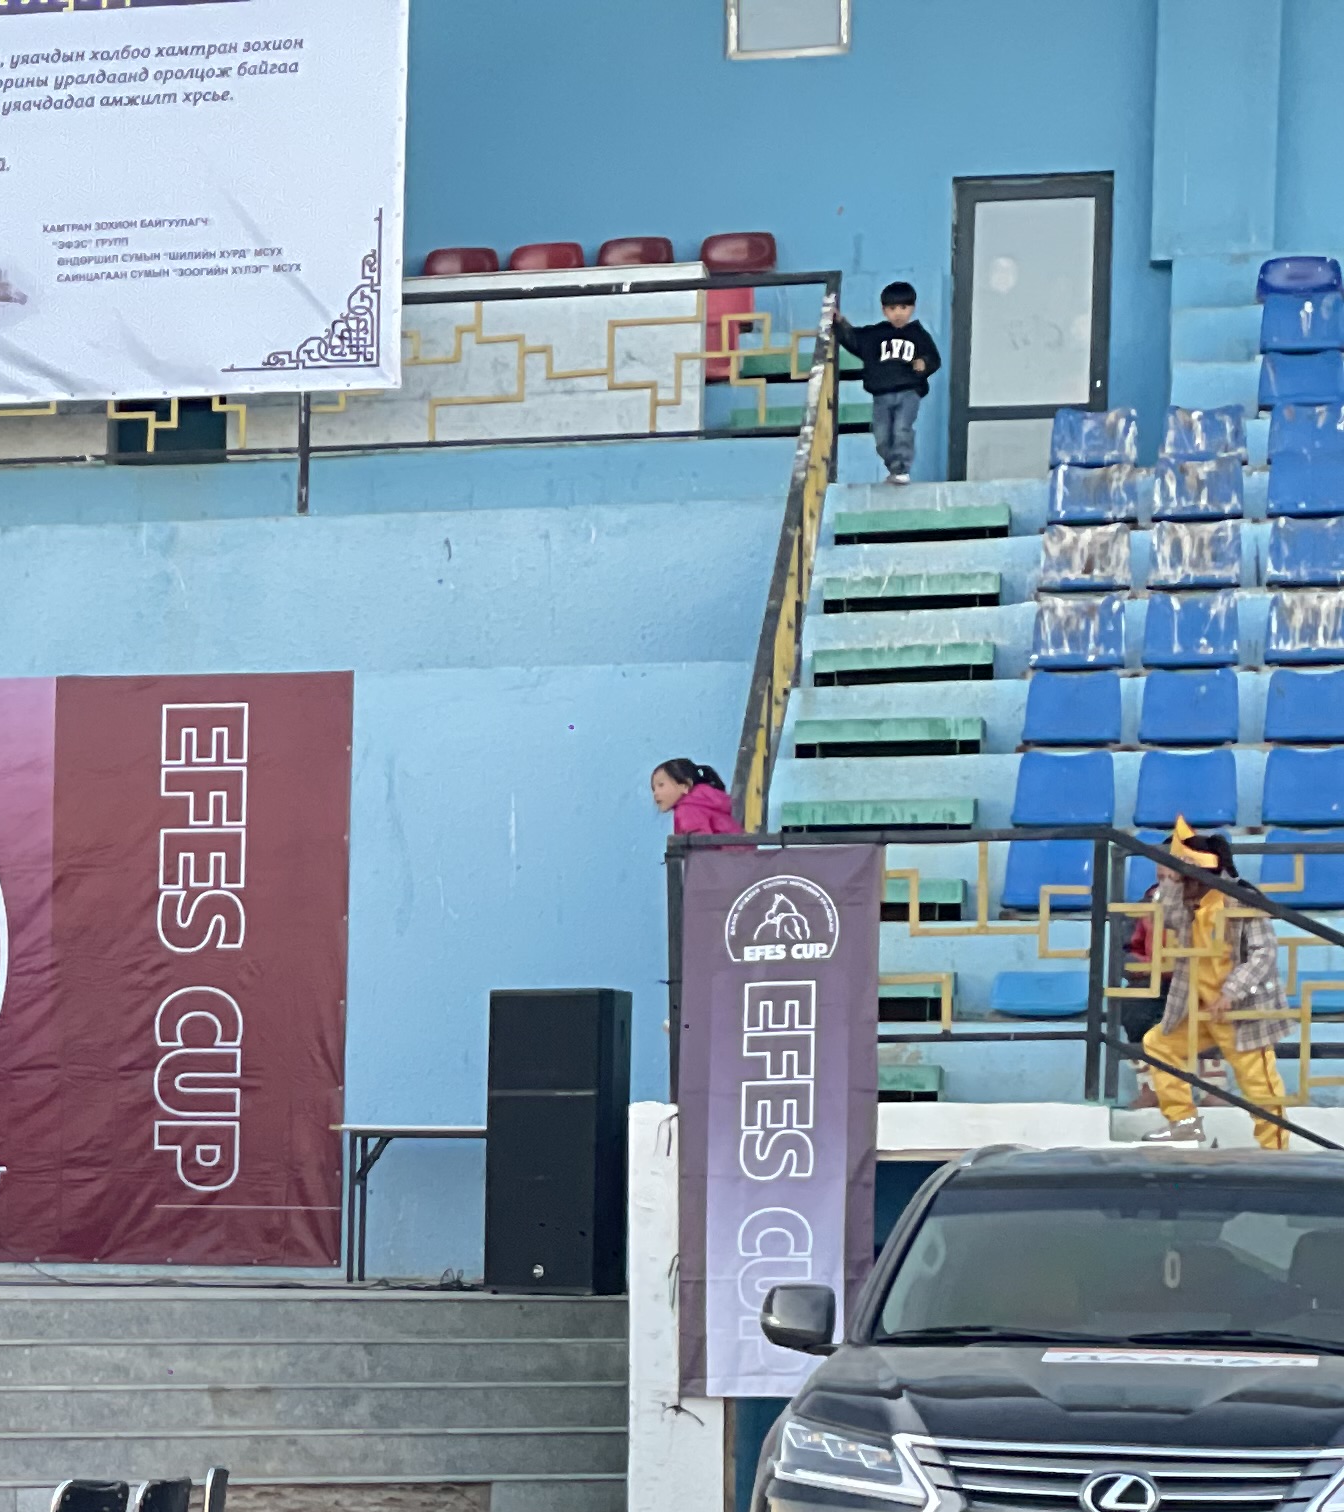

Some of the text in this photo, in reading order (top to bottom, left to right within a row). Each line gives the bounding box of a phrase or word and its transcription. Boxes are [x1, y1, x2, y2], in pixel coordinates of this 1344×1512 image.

[9, 48, 85, 68] уяачдын
[89, 44, 151, 61] холбоо
[155, 42, 238, 58] хамтран
[242, 38, 304, 53] зохион
[53, 67, 149, 91] уралдаанд
[153, 67, 232, 84] оролцож
[236, 61, 299, 77] байгаа
[1, 95, 95, 116] уяачдадаа
[99, 93, 177, 107] амжилт
[153, 702, 249, 1191] EFES CUP
[743, 943, 828, 961] EFES CUP
[739, 980, 816, 1181] EFES
